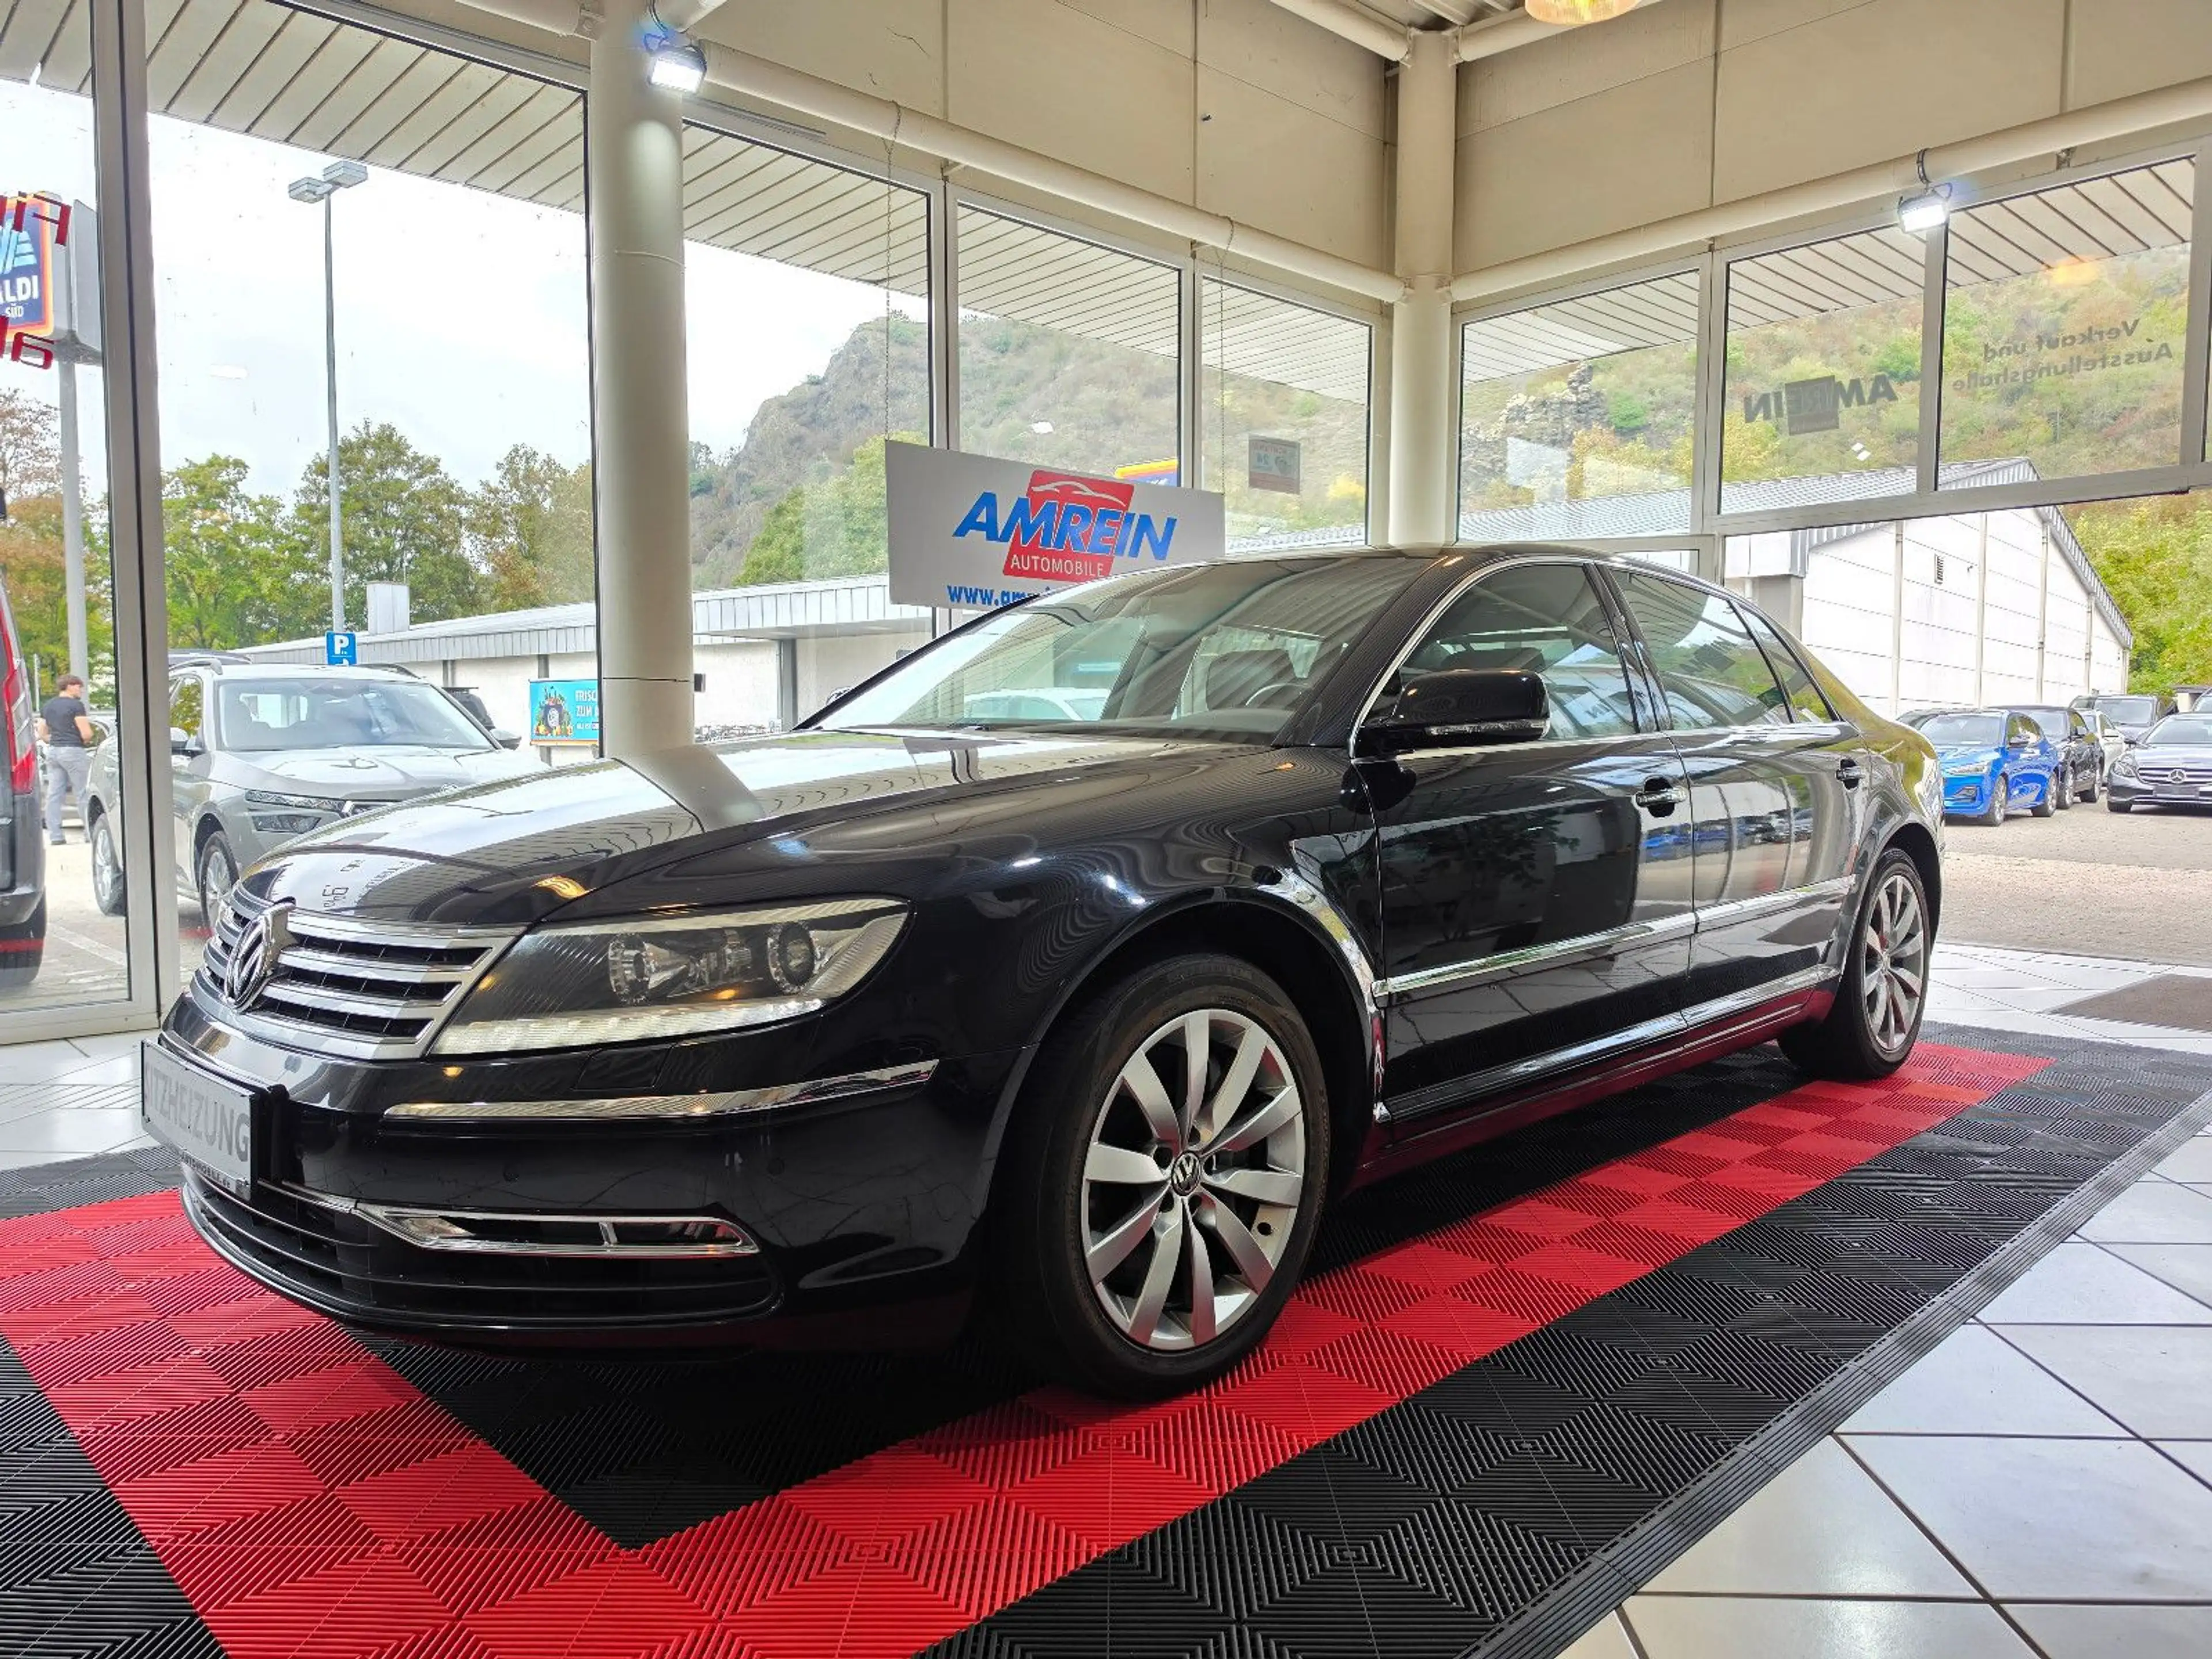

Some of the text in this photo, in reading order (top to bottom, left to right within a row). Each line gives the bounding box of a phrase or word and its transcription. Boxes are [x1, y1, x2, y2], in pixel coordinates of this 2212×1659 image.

[952, 491, 1178, 561] AMREIN
[1010, 554, 1104, 577] AUTOMOBILE
[334, 634, 350, 655] P
